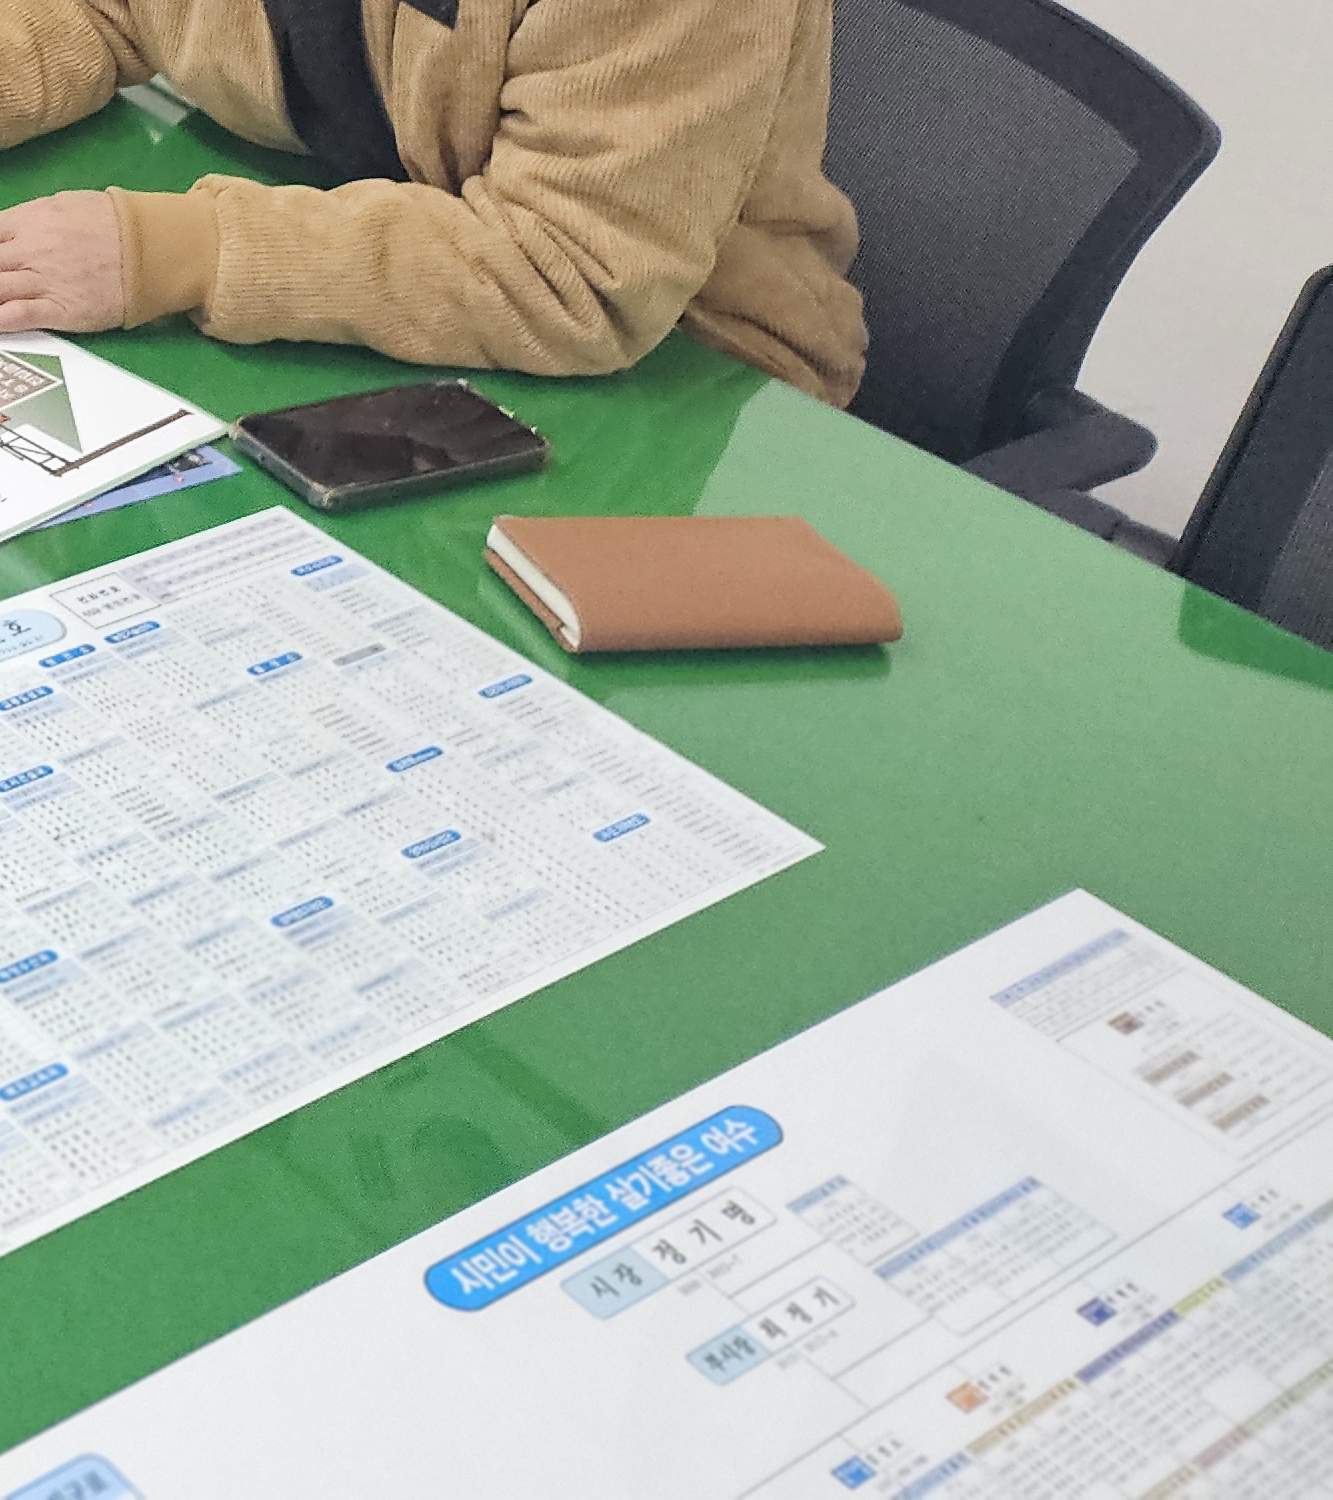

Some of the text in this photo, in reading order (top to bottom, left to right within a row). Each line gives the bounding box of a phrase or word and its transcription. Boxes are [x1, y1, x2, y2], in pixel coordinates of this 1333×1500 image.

[448, 1108, 763, 1302] 시민이 행복한 살기좋은 여수
[586, 1256, 644, 1307] 시장
[647, 1192, 759, 1273] 정기명
